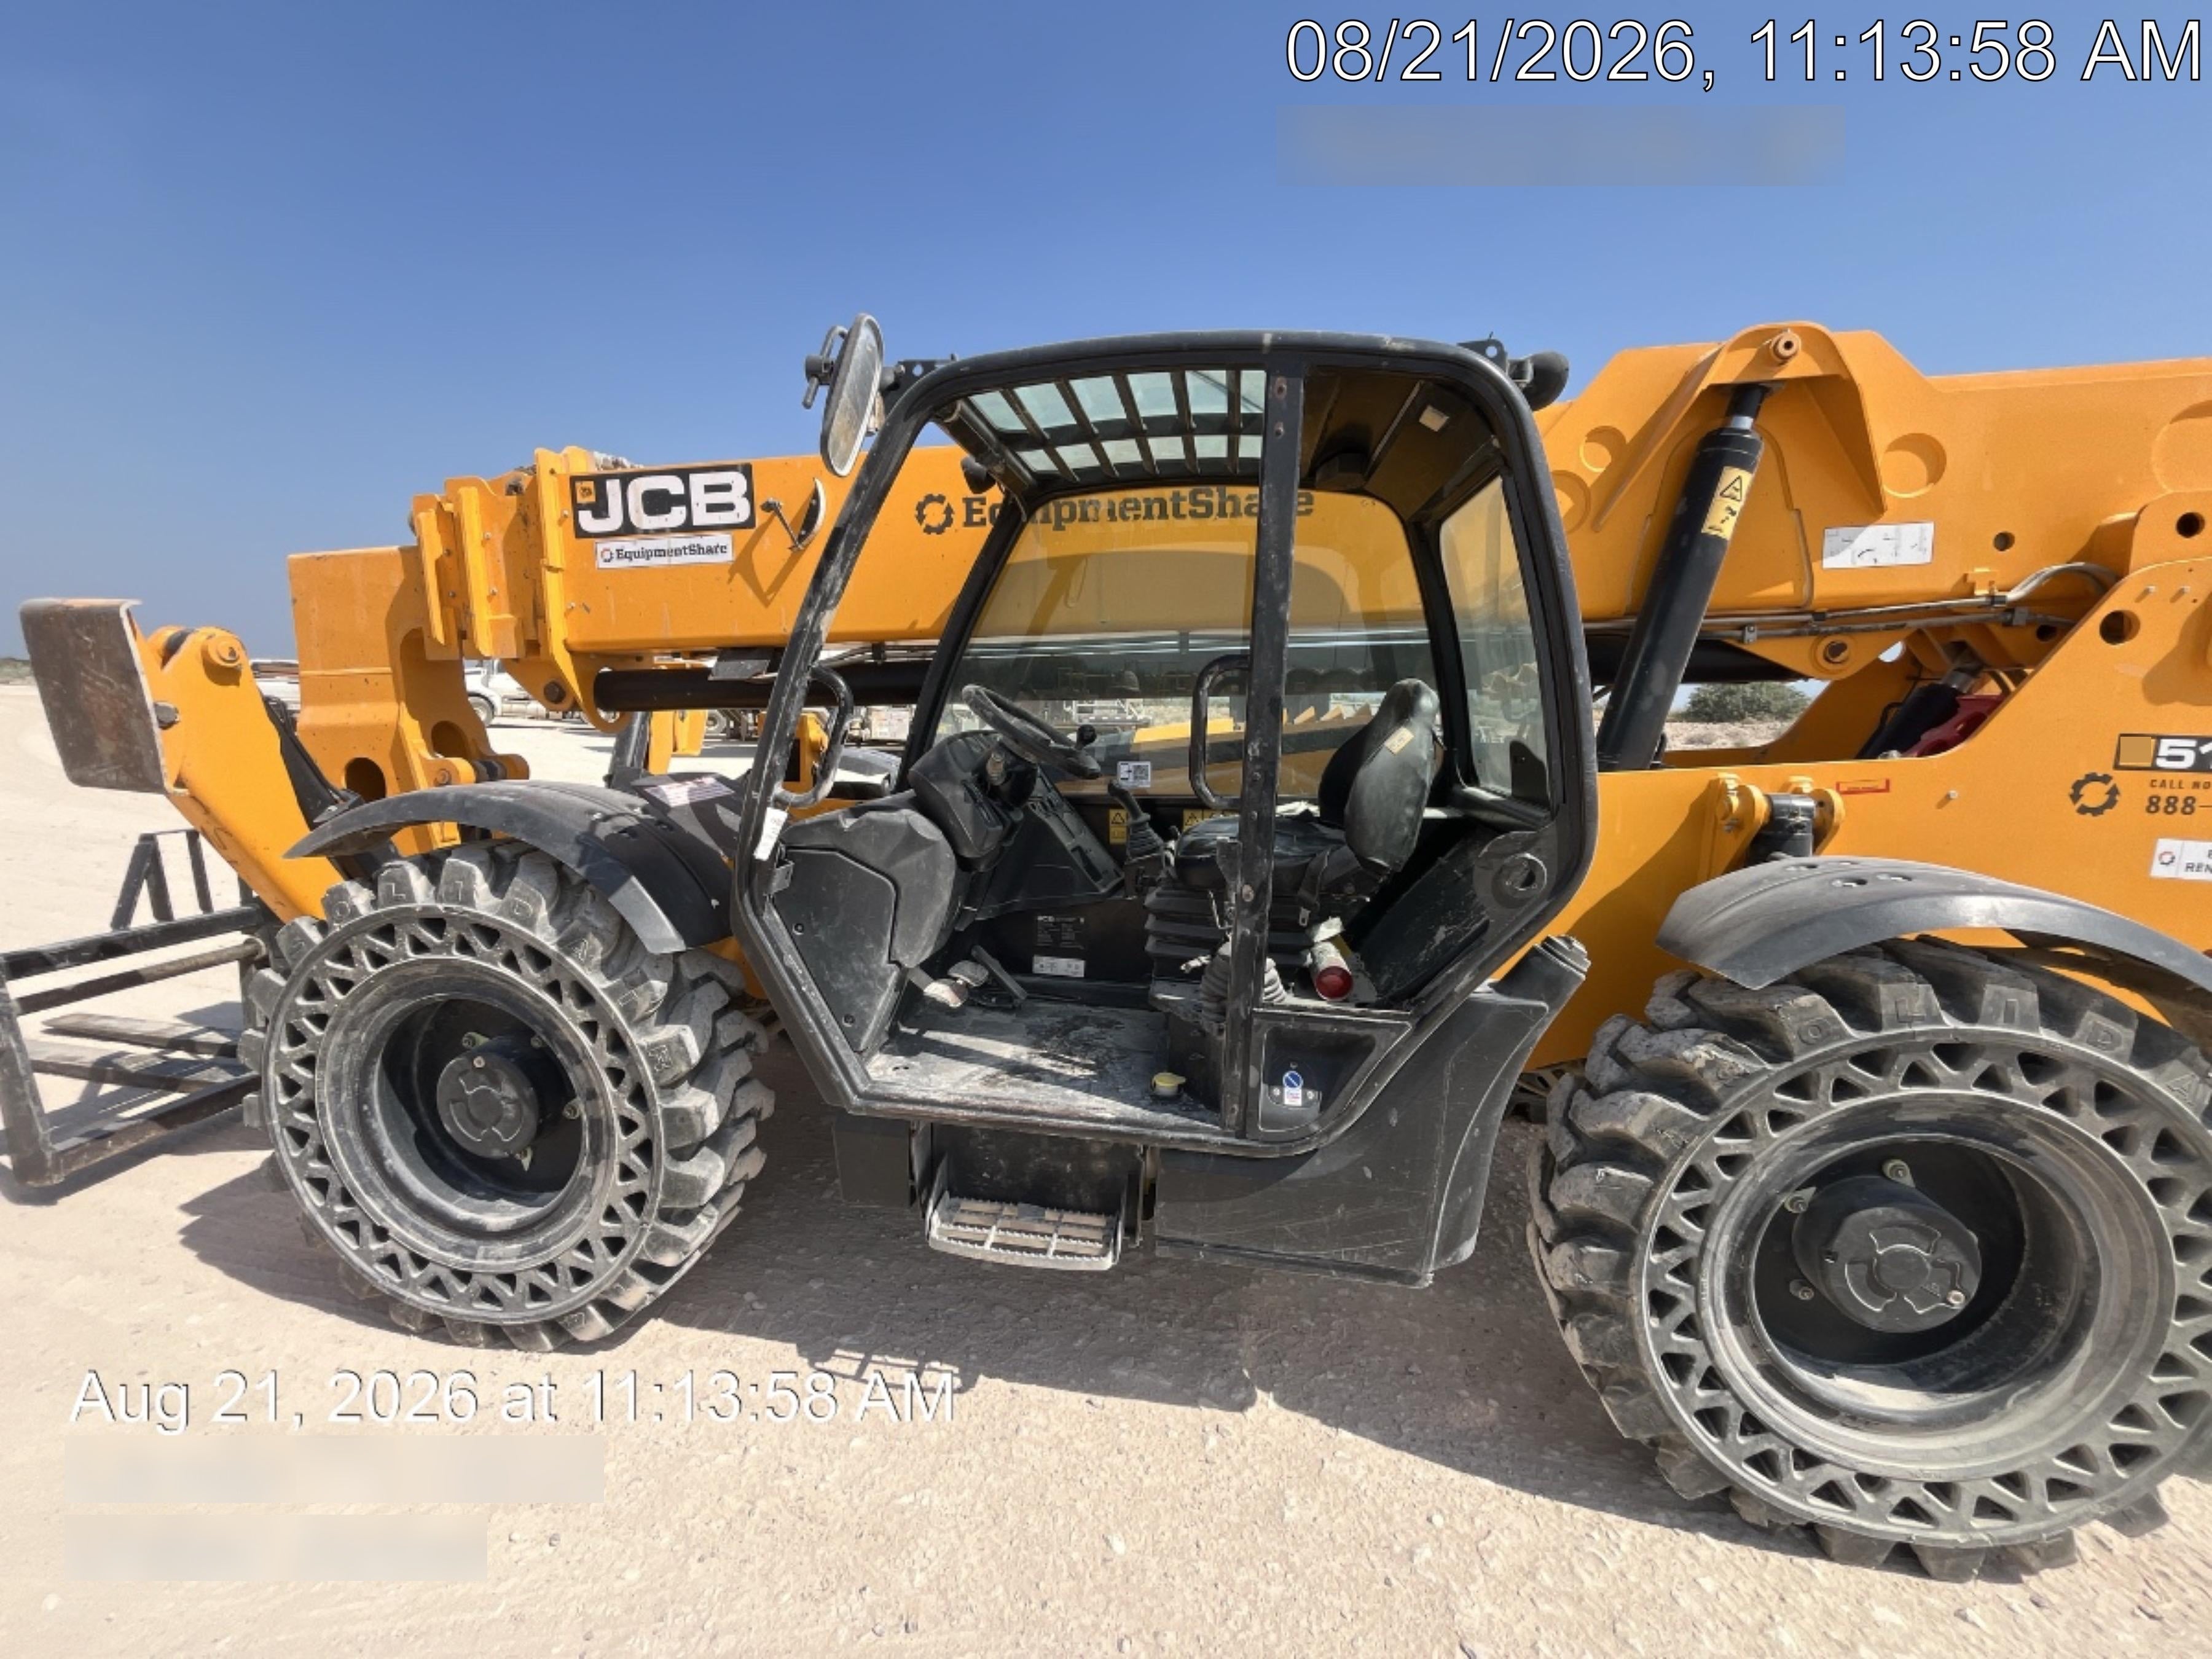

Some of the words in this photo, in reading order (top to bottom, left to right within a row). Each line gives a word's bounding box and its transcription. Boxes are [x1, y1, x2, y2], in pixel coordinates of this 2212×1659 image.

[578, 471, 751, 533] JCB
[615, 543, 728, 562] EquipmentShare
[2150, 779, 2185, 790] CALL
